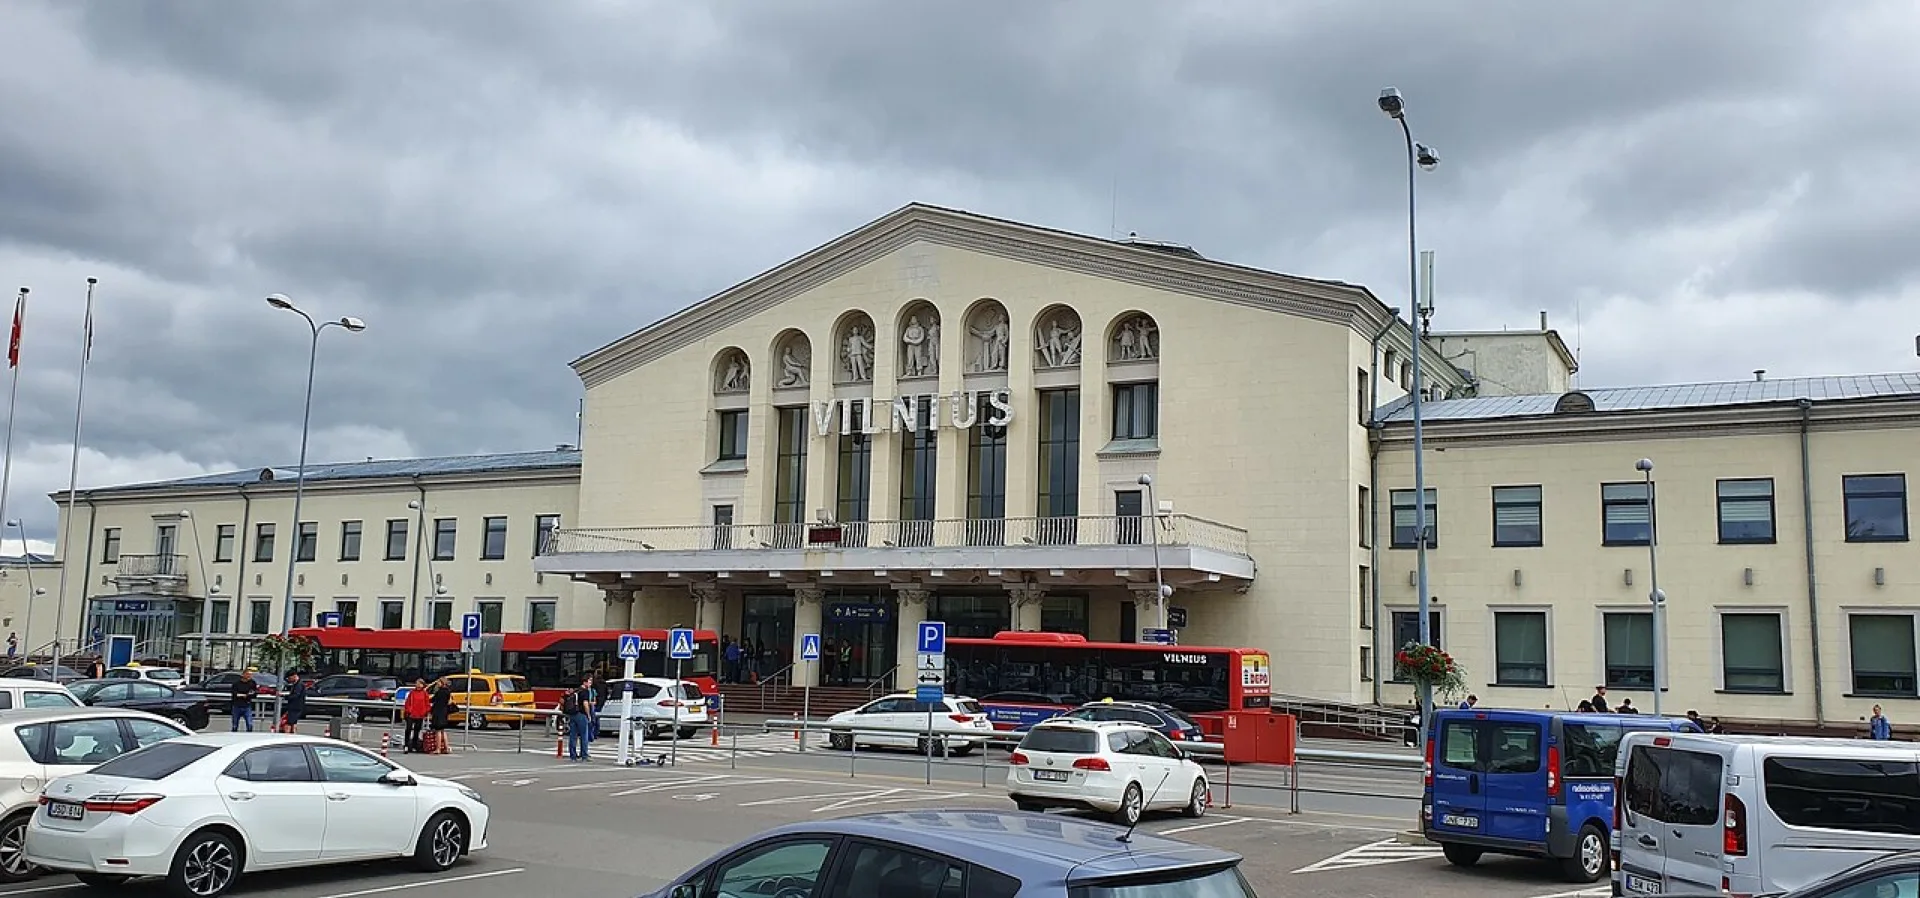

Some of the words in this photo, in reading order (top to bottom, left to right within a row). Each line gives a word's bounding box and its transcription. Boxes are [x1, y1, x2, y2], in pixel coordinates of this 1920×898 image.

[811, 387, 1014, 436] VILNIUS
[466, 616, 478, 637] P
[924, 626, 938, 649] P
[1163, 653, 1207, 665] VILNIUS
[1250, 673, 1268, 685] DEPO
